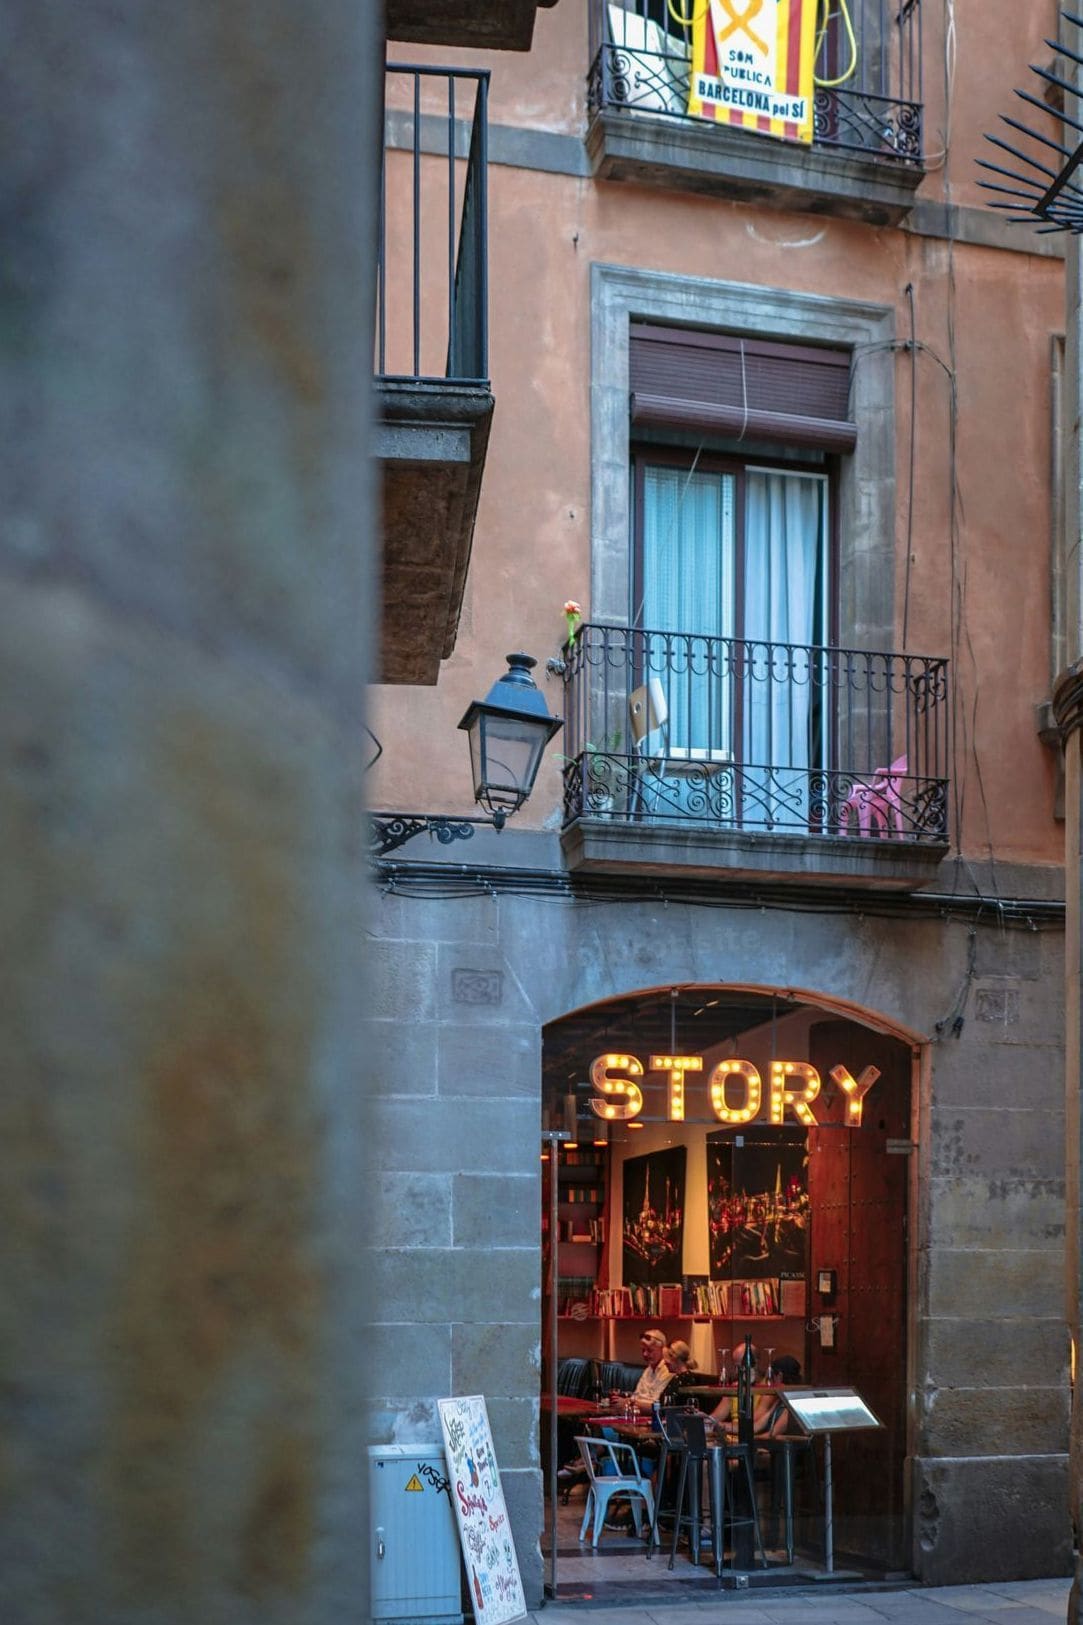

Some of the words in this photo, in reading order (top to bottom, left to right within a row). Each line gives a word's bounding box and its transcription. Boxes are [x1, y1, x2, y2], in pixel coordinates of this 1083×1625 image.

[729, 49, 754, 65] SOM
[698, 79, 770, 112] BARCELONA
[772, 103, 789, 116] pel
[588, 1053, 881, 1127] STORY
